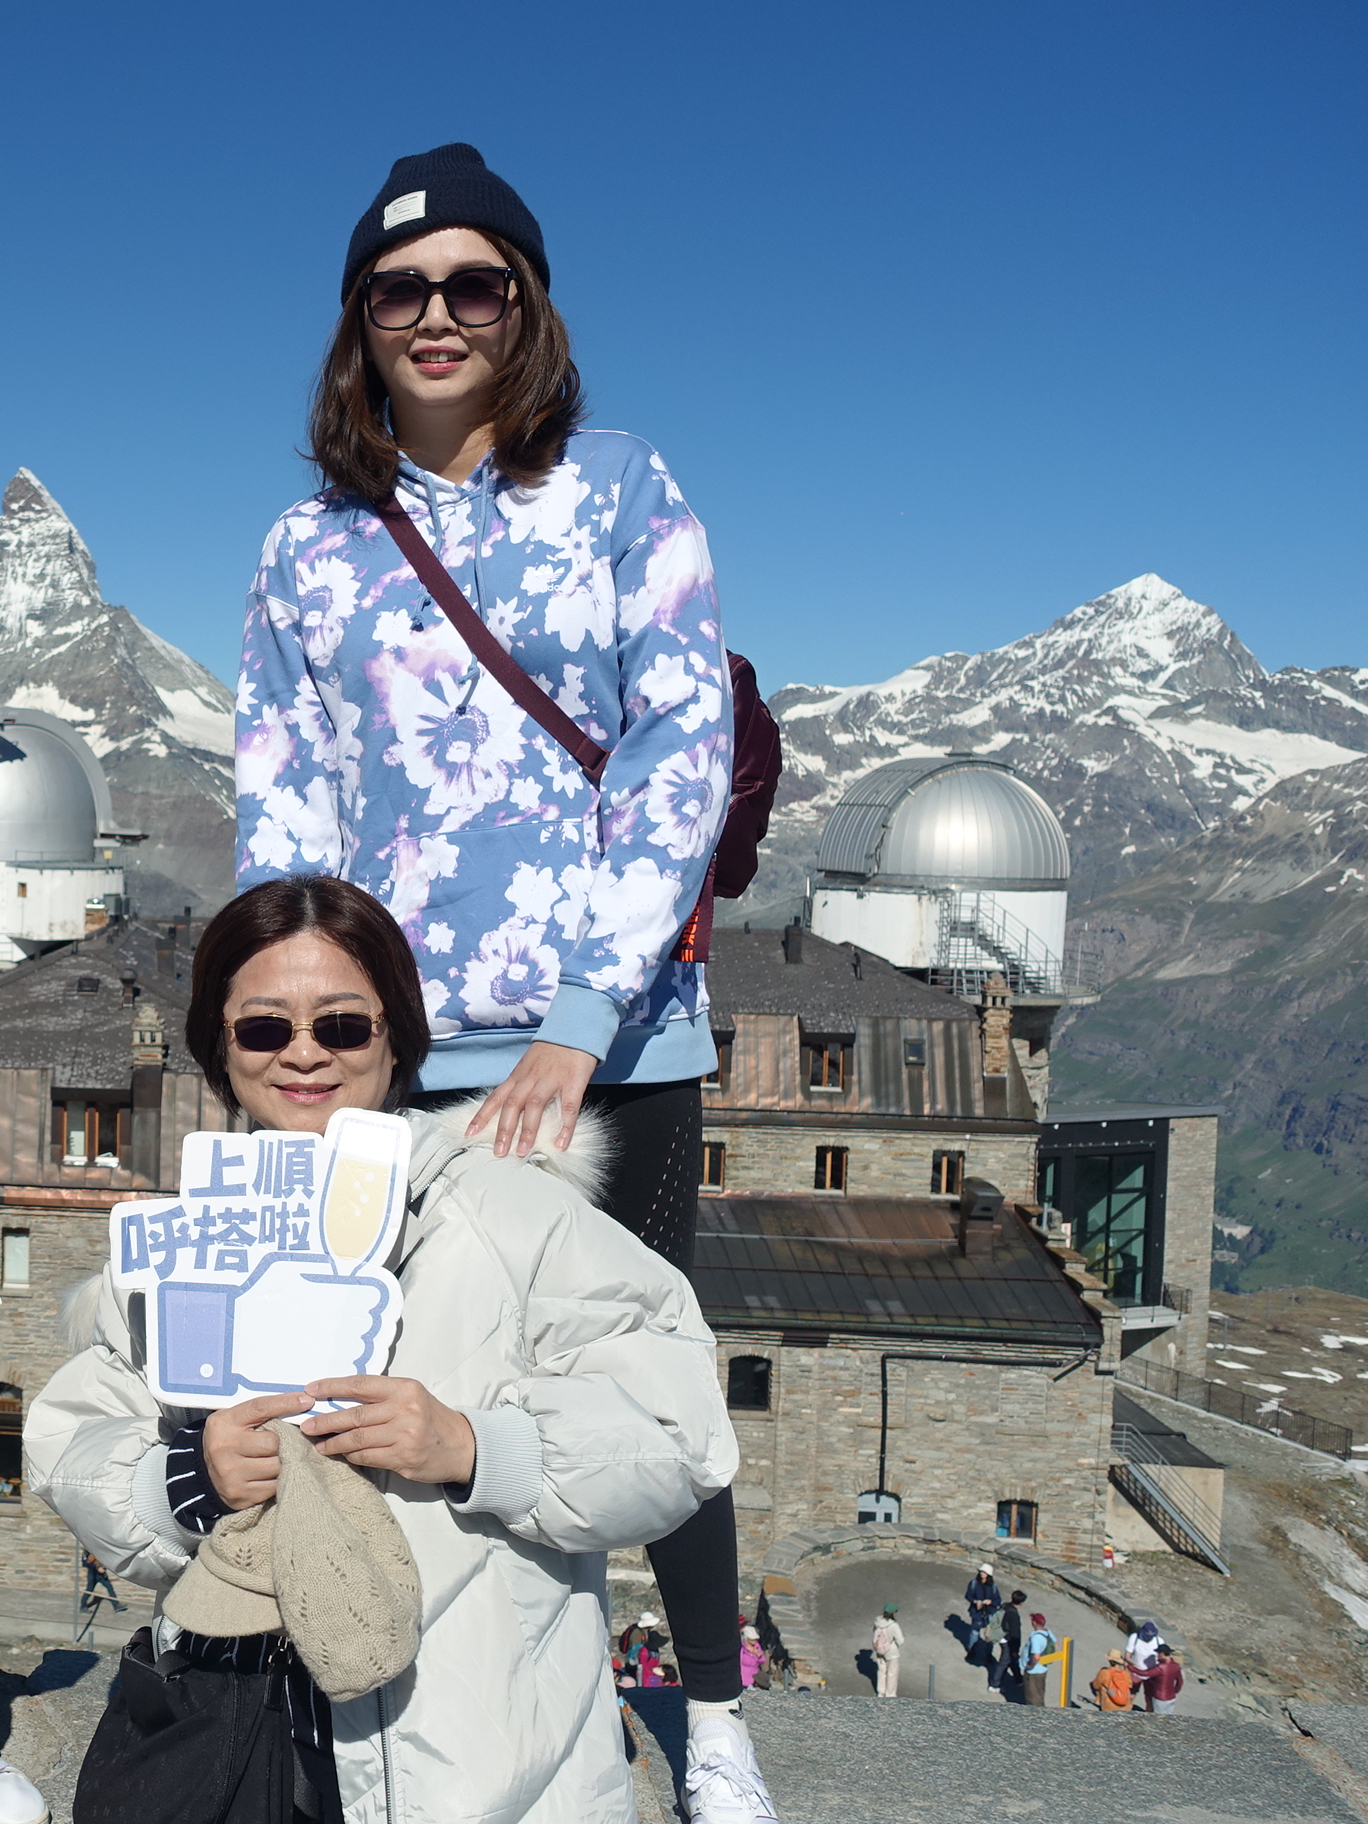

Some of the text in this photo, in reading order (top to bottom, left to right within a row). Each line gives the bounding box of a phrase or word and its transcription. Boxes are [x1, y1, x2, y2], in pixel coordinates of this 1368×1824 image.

[188, 1138, 316, 1200] 上順
[120, 1201, 311, 1281] 呼搭啦
